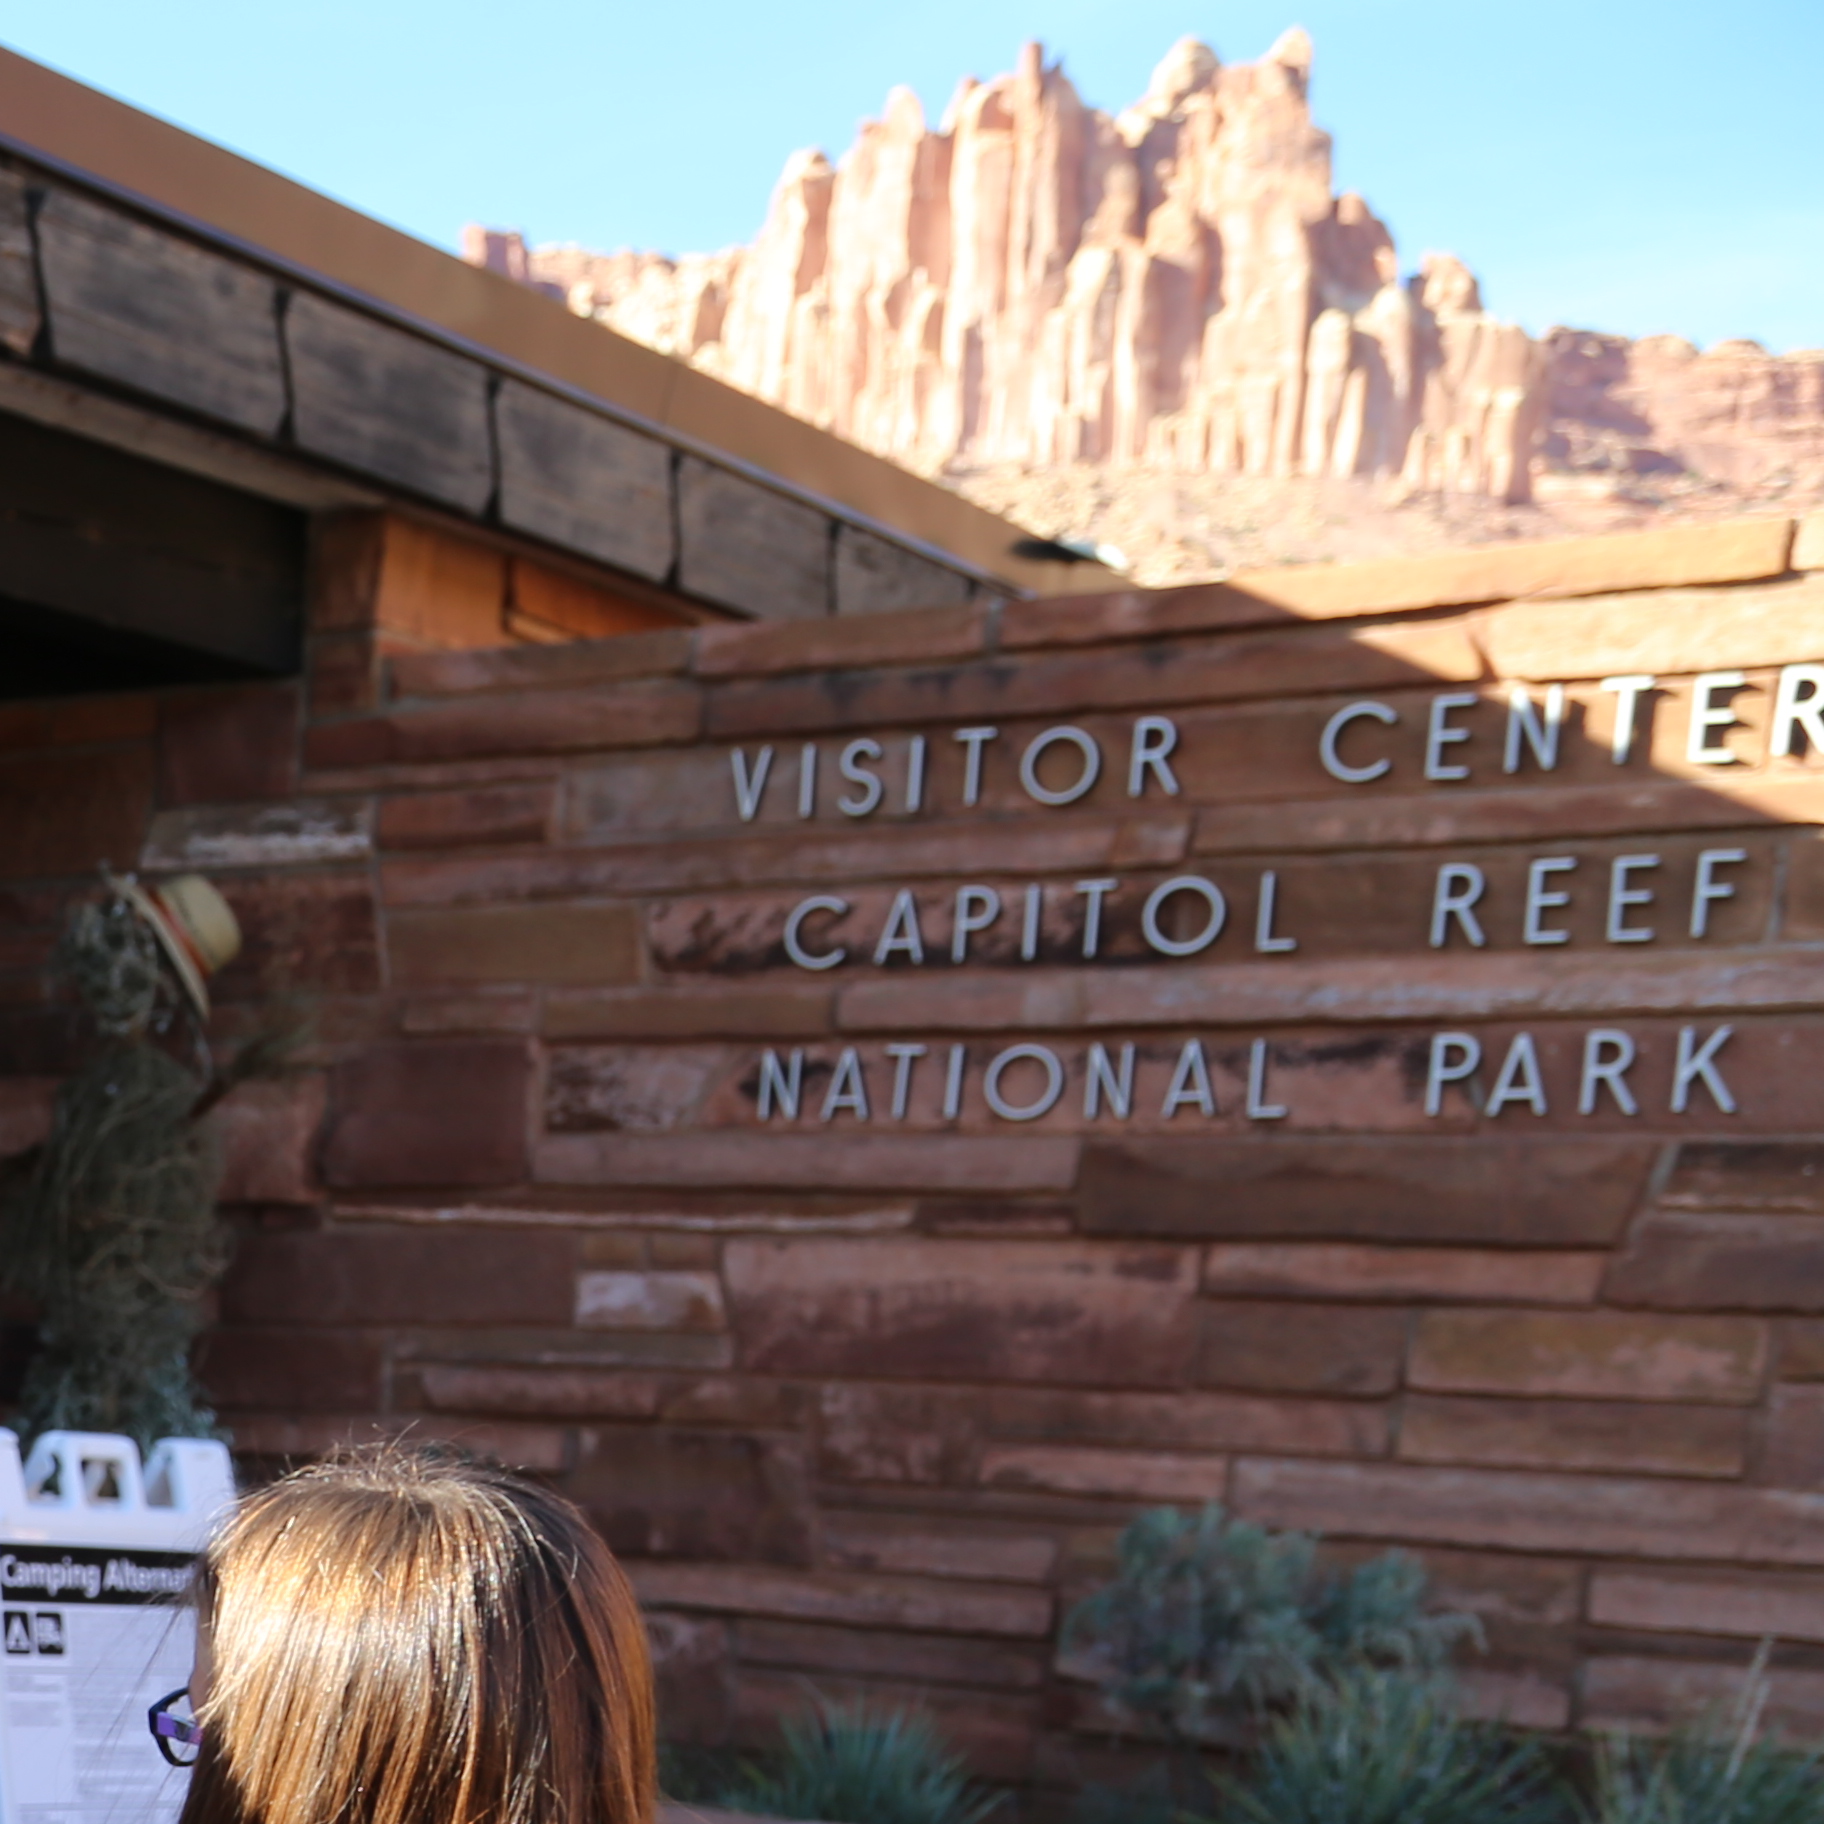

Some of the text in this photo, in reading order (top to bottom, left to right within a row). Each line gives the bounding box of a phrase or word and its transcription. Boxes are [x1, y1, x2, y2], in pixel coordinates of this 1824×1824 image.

[731, 663, 1824, 822] VISITOR CENTER
[783, 847, 1748, 972] CAPITOL REEF
[756, 1023, 1738, 1123] NATIONAL PARK
[0, 1554, 197, 1598] Camping Alterna
